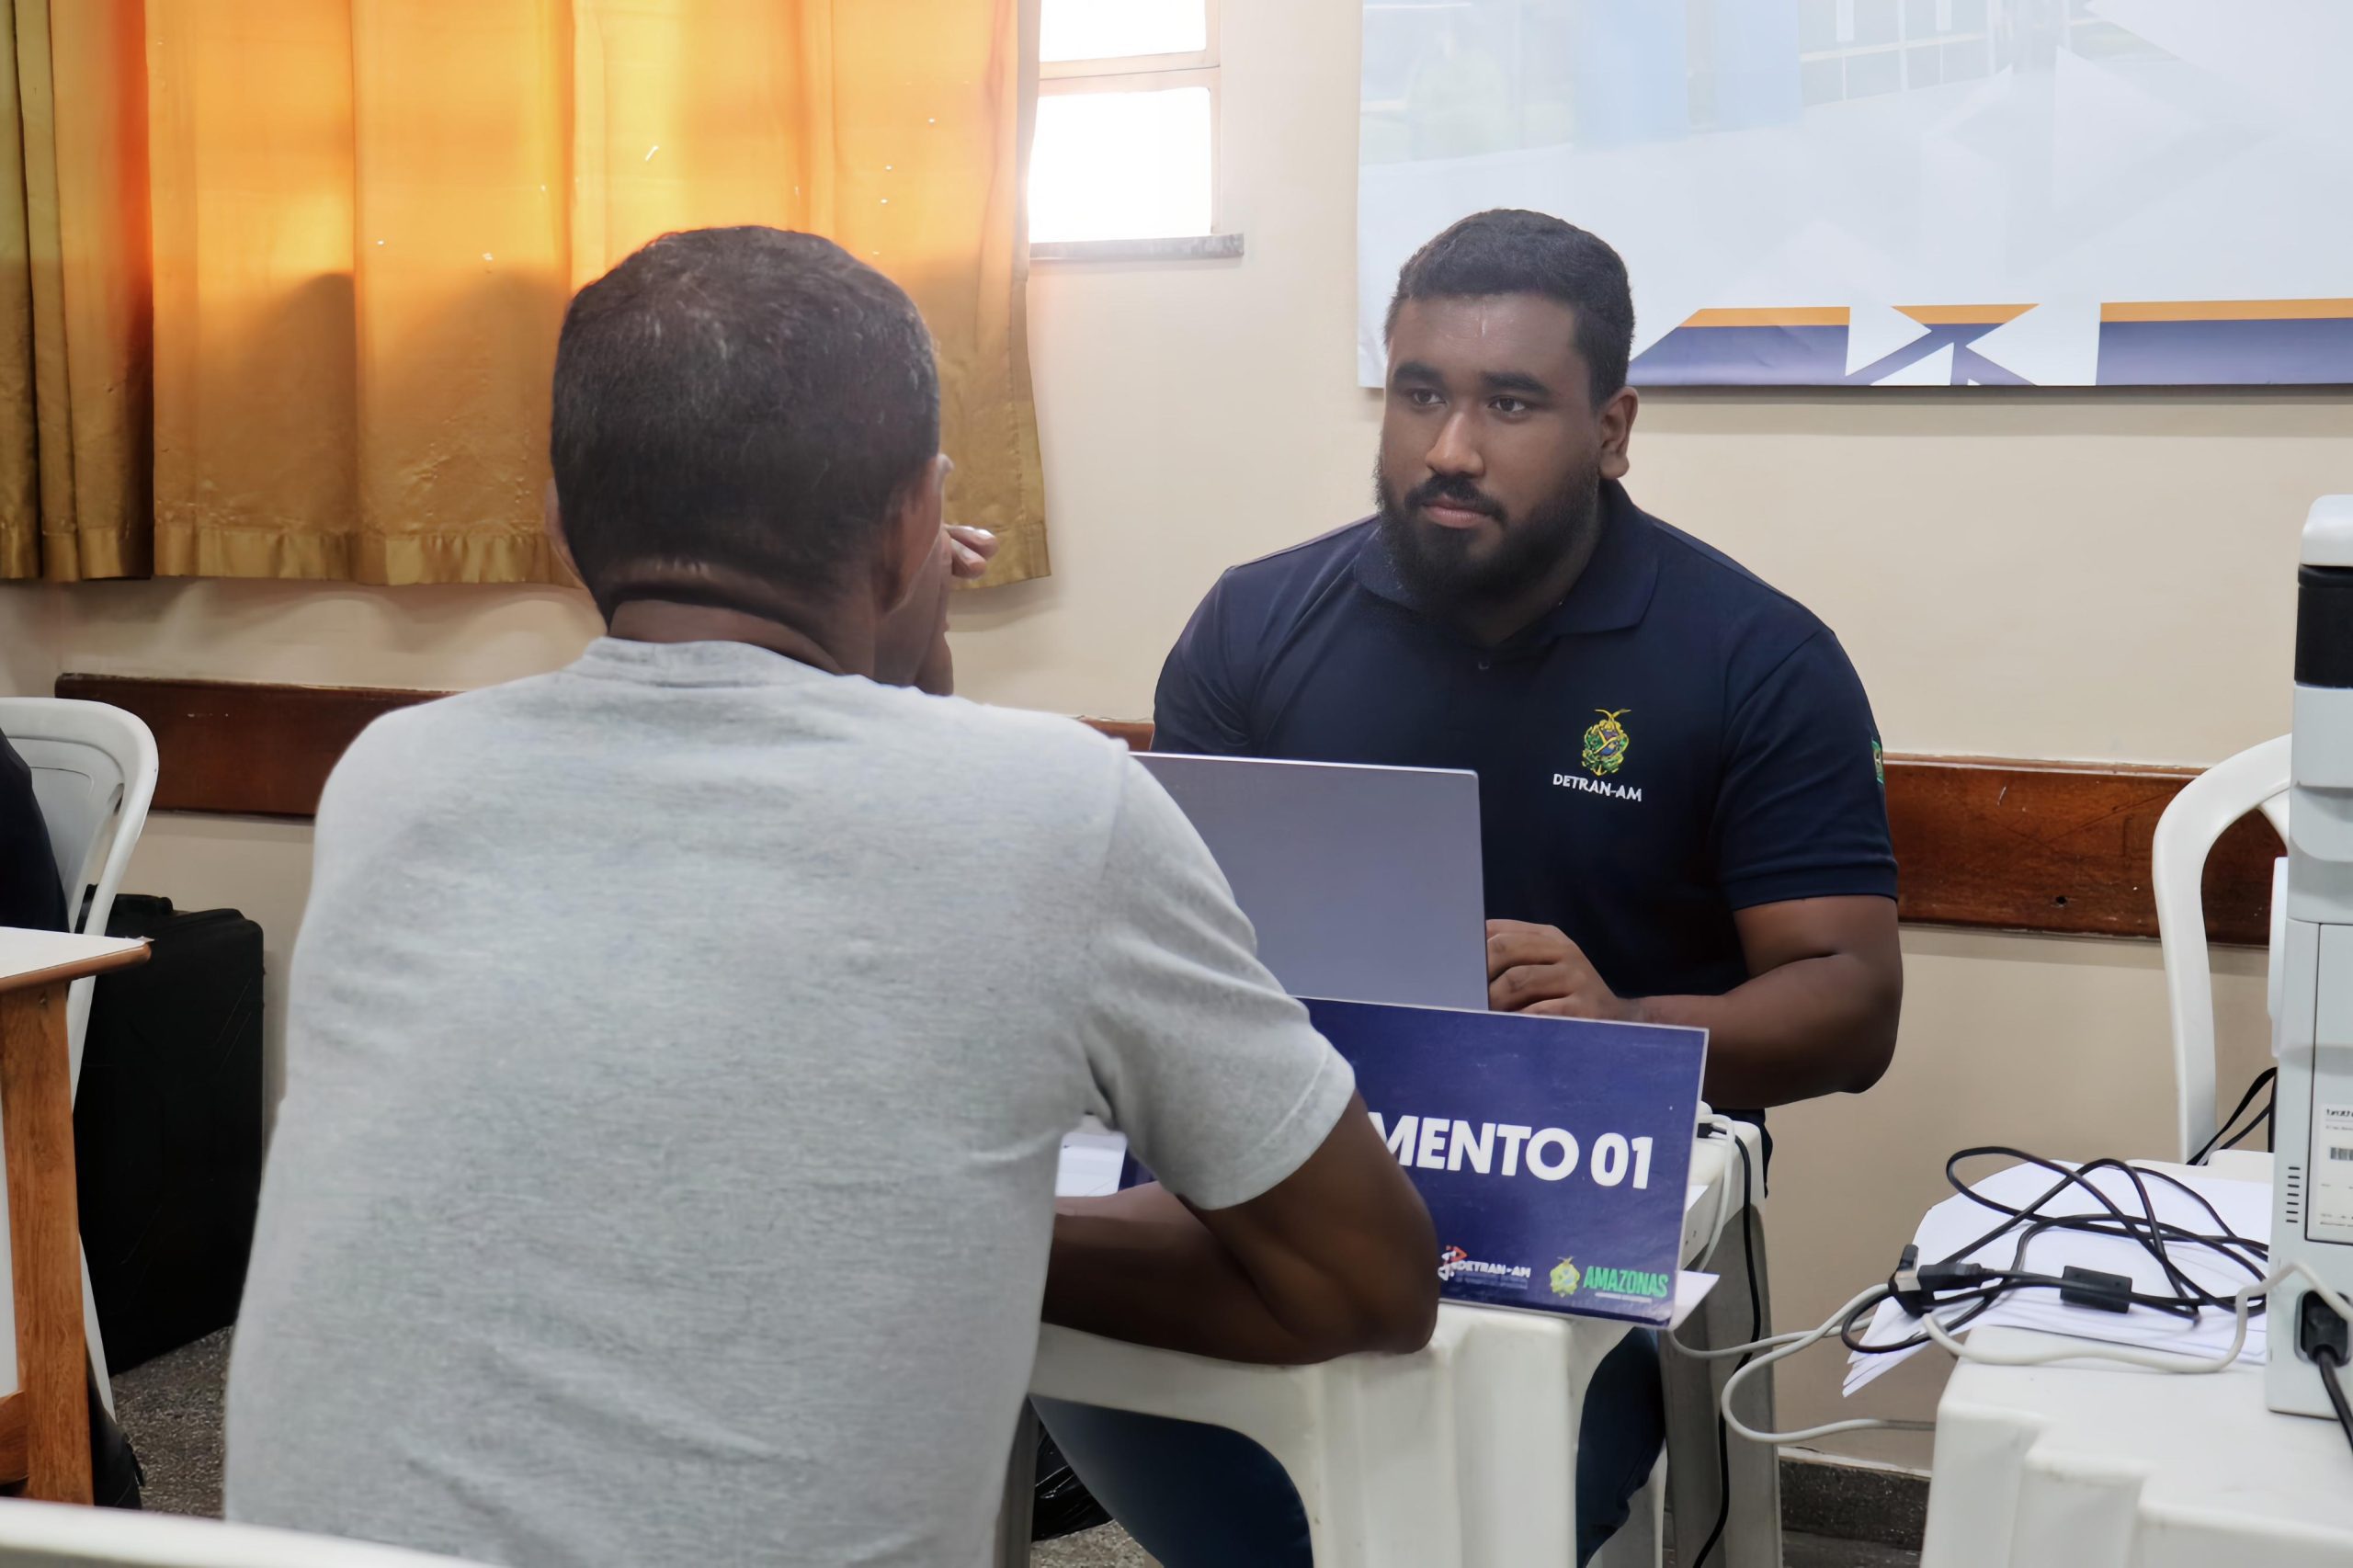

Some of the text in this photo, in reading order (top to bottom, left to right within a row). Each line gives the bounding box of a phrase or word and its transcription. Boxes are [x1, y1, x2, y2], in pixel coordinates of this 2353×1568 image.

[1552, 773, 1642, 801] DETRAN-AM
[1590, 1132, 1654, 1189] 01
[1583, 1265, 1669, 1298] AMAZONAS
